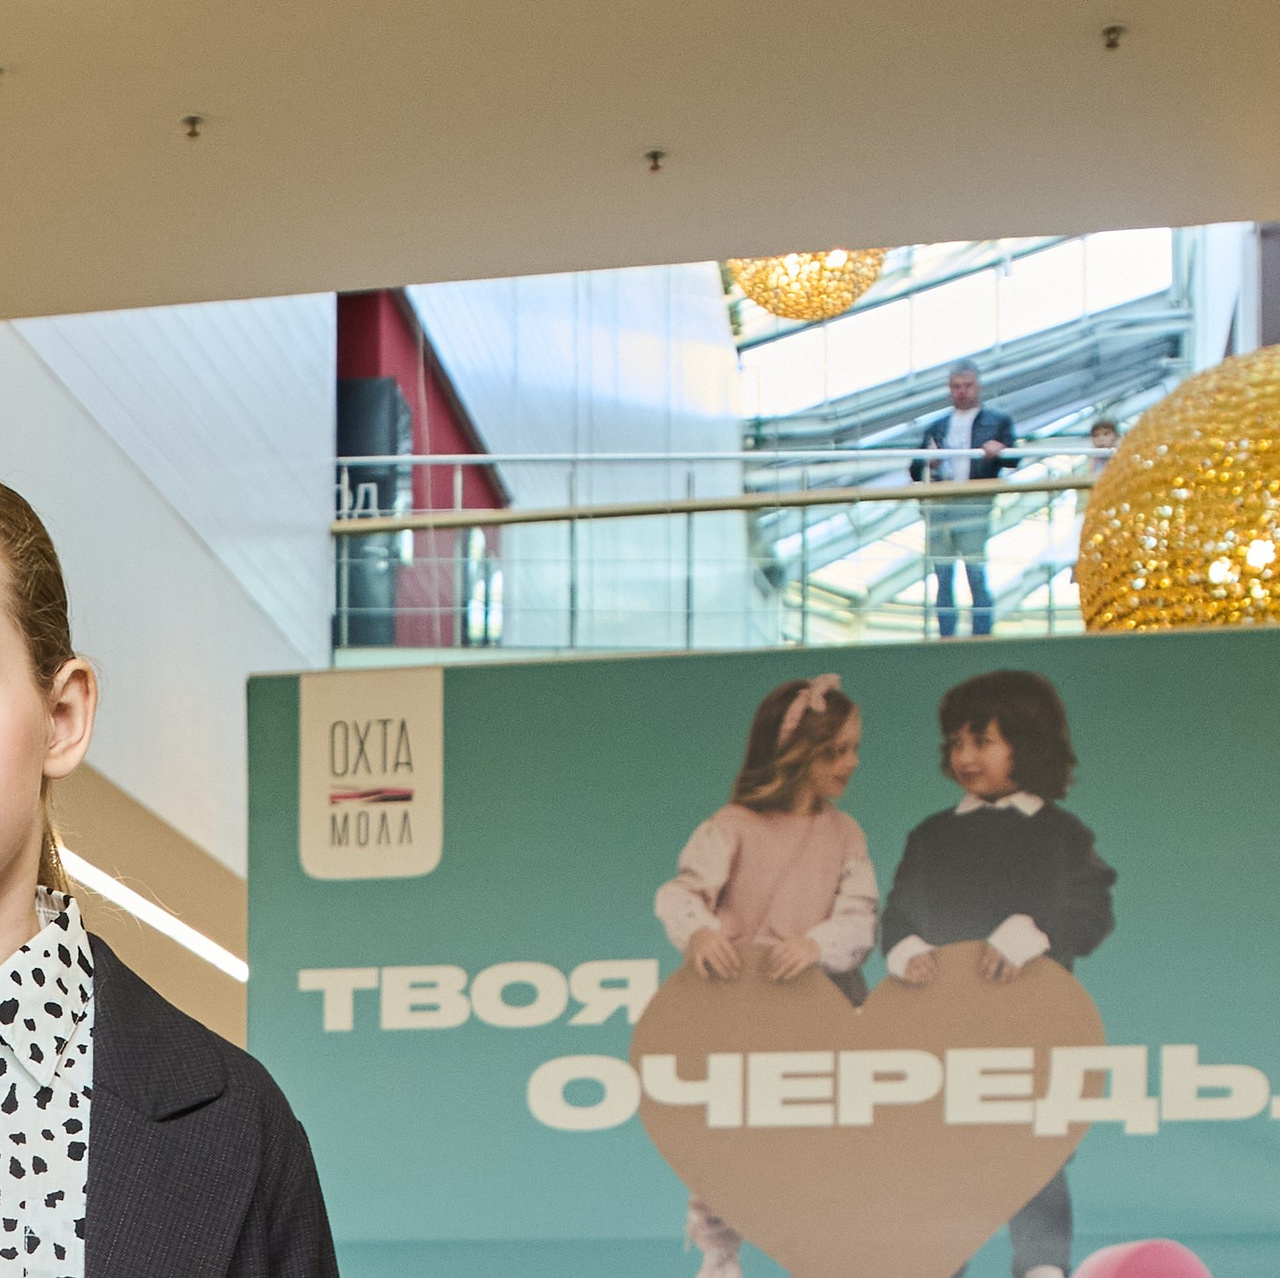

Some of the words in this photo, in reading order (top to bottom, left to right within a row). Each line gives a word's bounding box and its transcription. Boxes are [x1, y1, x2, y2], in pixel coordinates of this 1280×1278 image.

[330, 719, 413, 778] ОХТА
[330, 811, 413, 847] МОЛЛ
[298, 958, 660, 1032] ТВОЯ
[527, 1043, 1280, 1136] ОЧЕРЕДЬ
